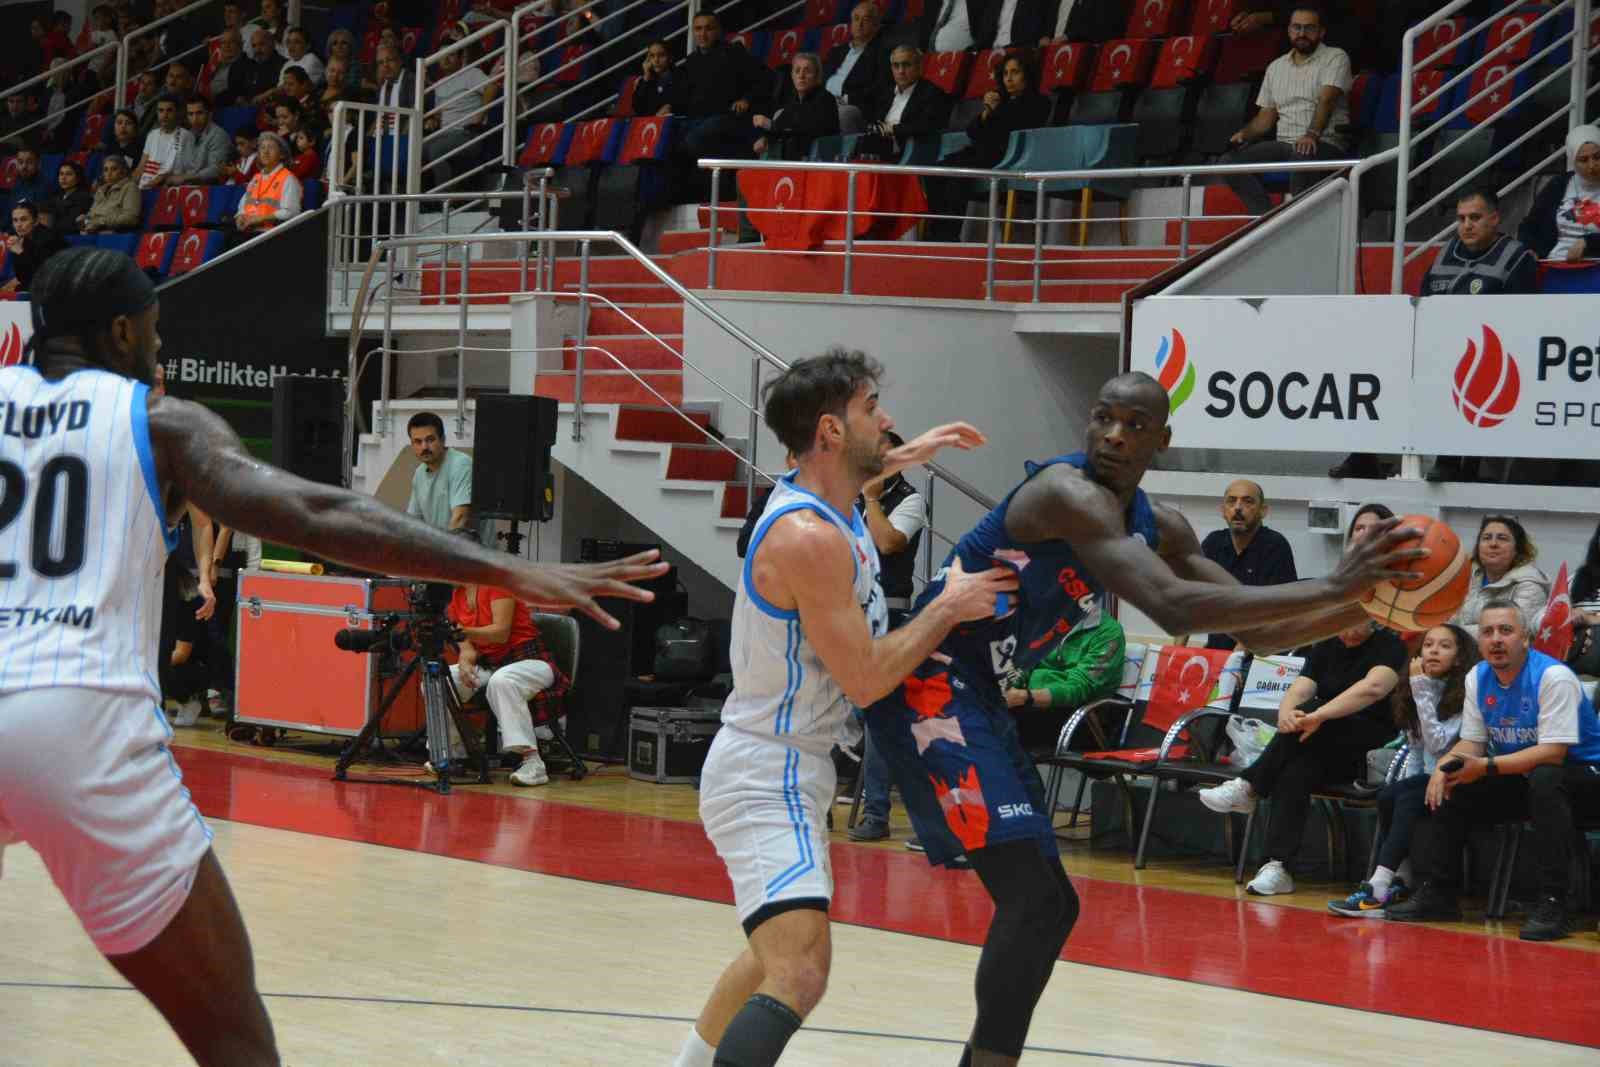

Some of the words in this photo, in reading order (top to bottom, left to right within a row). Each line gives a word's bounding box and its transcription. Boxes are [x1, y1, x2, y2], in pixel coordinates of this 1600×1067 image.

[166, 358, 350, 388] #BirlikteH
[1537, 336, 1600, 382] Pe
[1205, 371, 1381, 420] SOCAR
[0, 400, 91, 439] LOYD
